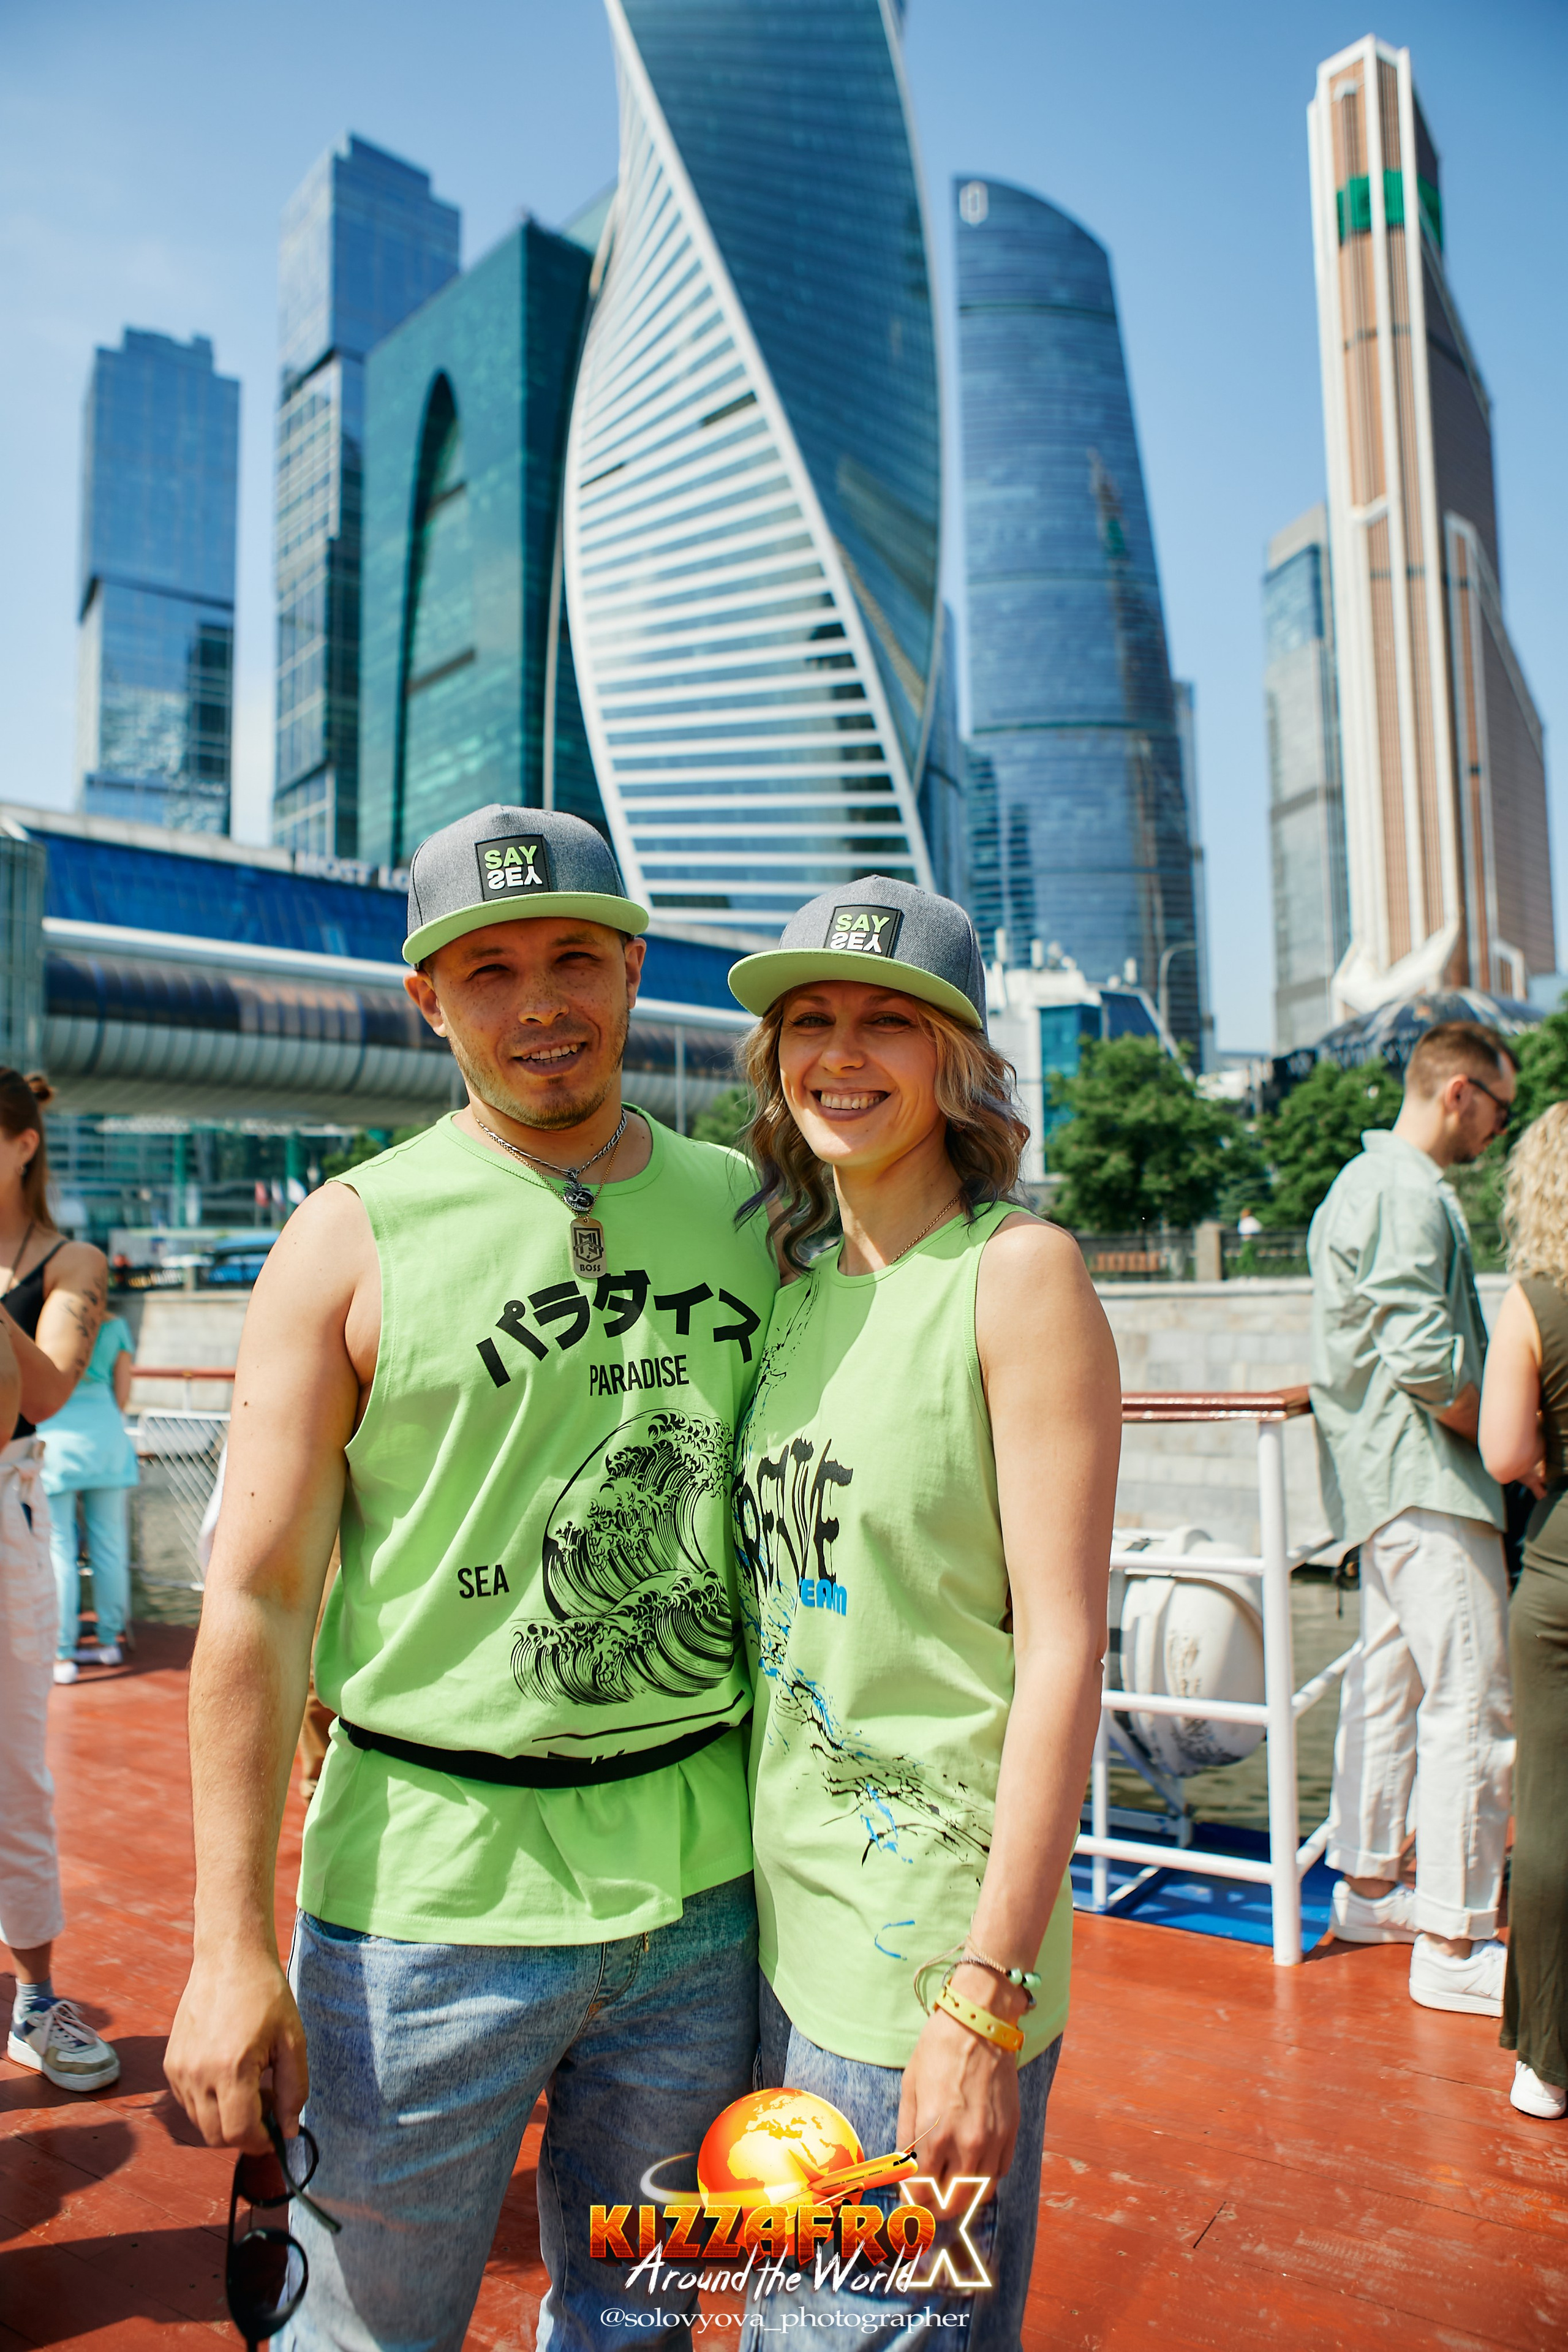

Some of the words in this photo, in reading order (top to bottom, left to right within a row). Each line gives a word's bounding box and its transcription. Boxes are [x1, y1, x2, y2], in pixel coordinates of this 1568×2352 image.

[484, 845, 537, 870] SAY
[835, 914, 890, 933] SAY
[590, 1354, 690, 1396] PARADISE
[458, 1564, 510, 1599] SEA
